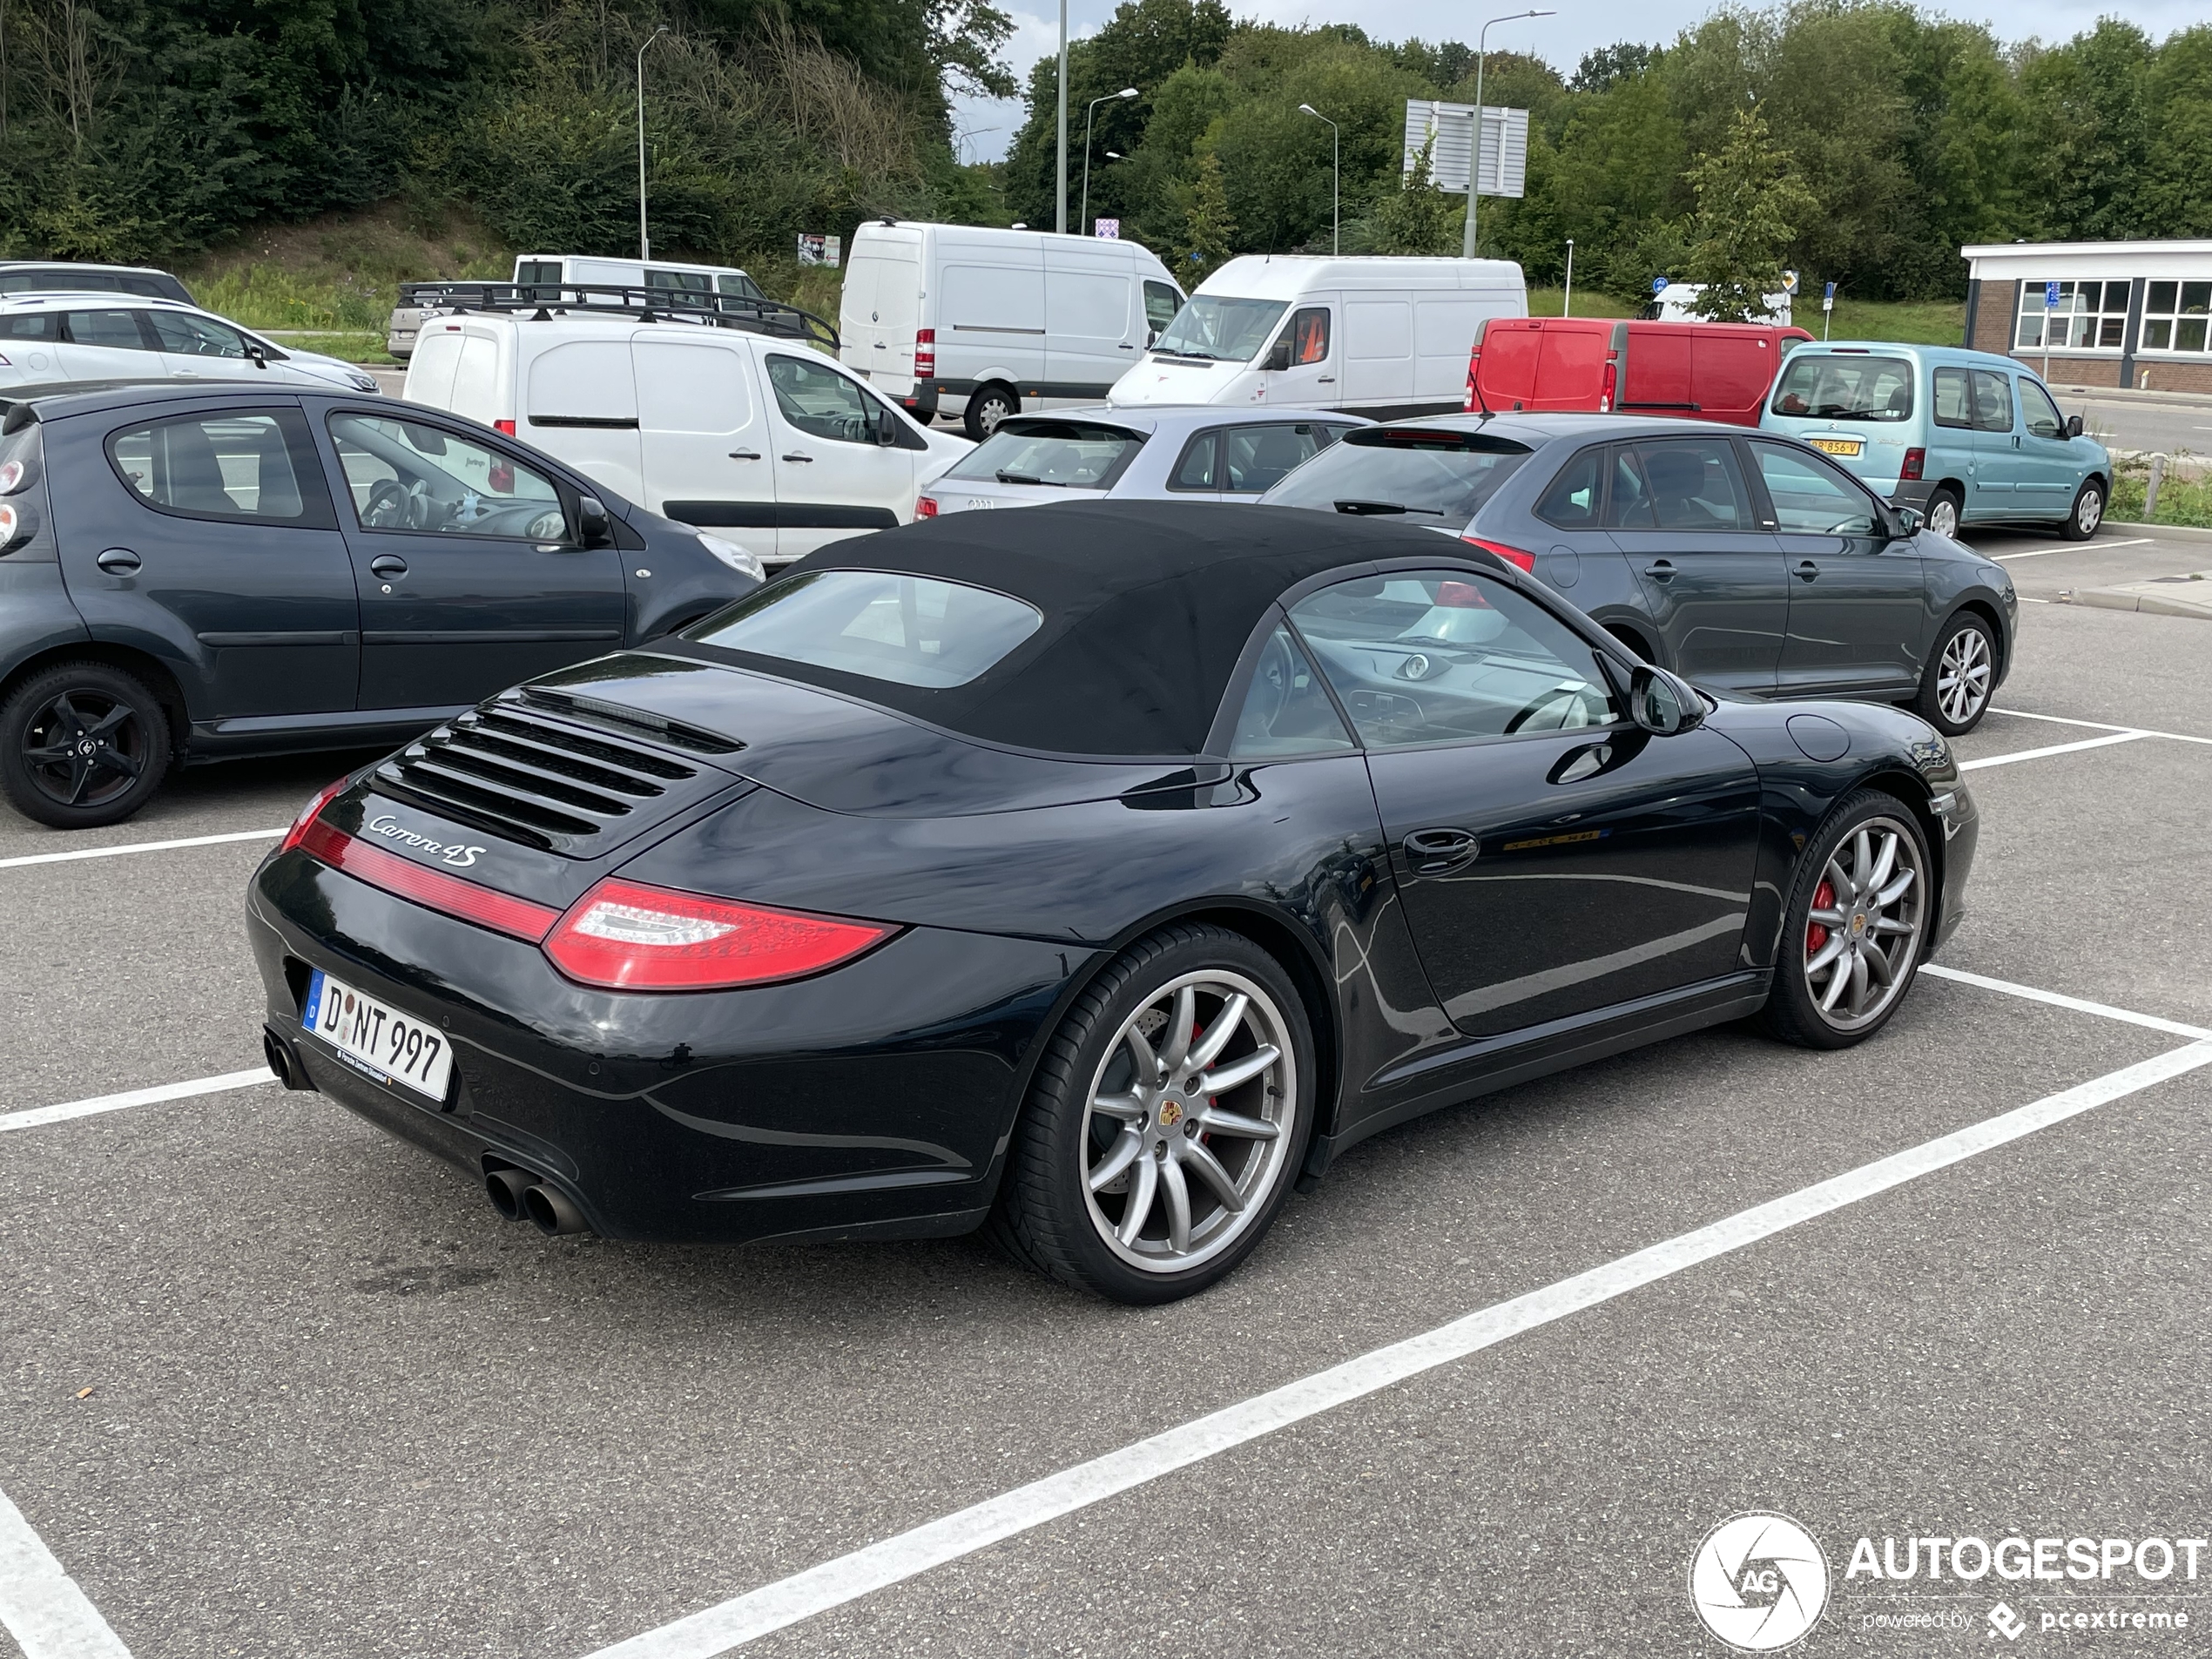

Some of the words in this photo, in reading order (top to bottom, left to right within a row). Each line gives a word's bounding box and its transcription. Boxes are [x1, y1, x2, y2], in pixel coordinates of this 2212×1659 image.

[369, 815, 442, 854] Carrera
[442, 845, 488, 867] 4S
[309, 1005, 316, 1019] D
[324, 986, 342, 1033] D
[352, 1001, 387, 1055] NT
[388, 1021, 441, 1082] 997
